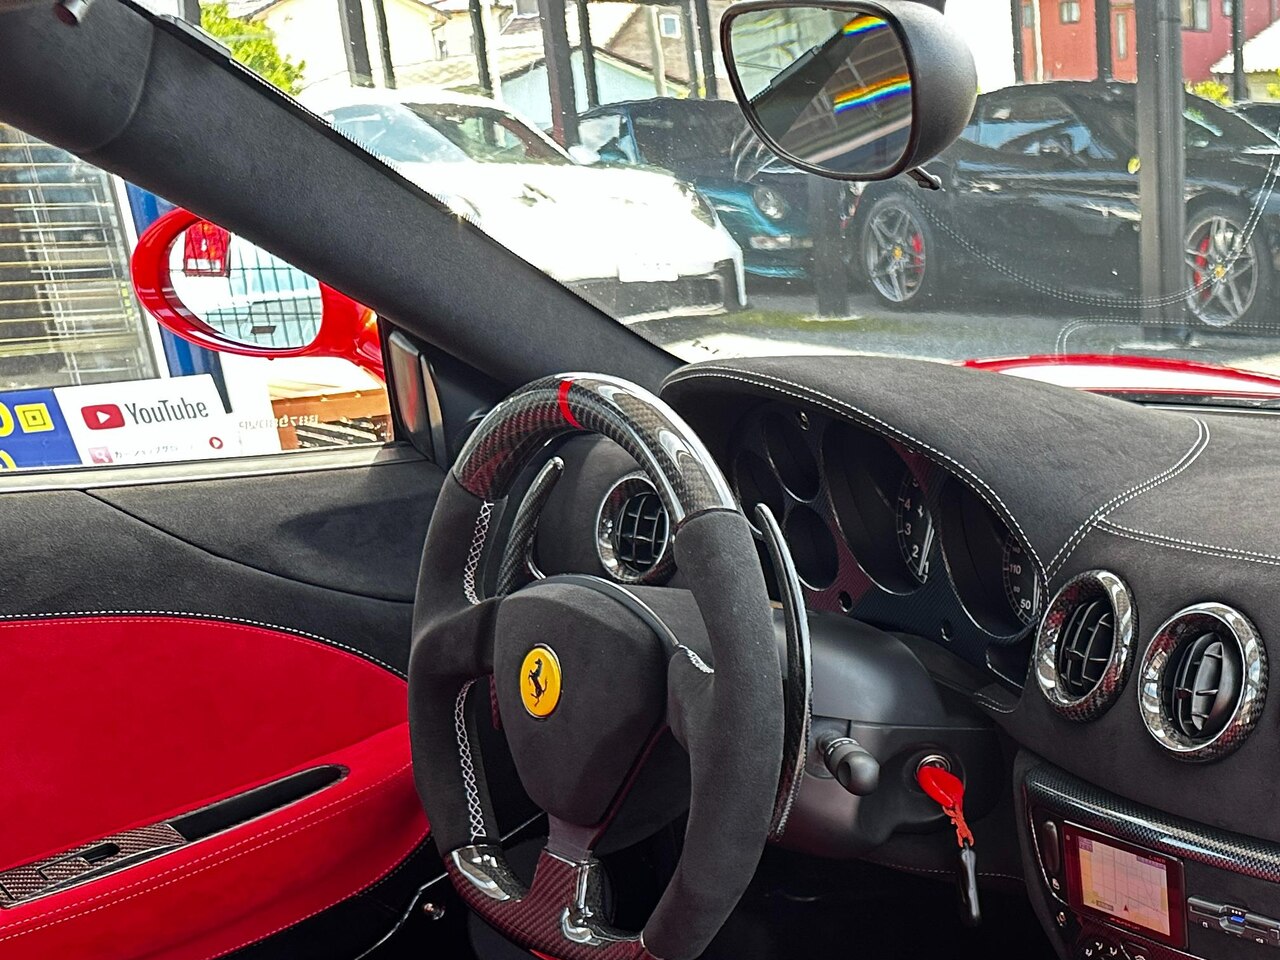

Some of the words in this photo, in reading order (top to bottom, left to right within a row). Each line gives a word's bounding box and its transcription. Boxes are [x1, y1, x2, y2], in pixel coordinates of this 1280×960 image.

[124, 397, 209, 425] YouTube
[912, 544, 919, 558] 2
[1020, 598, 1031, 610] 50
